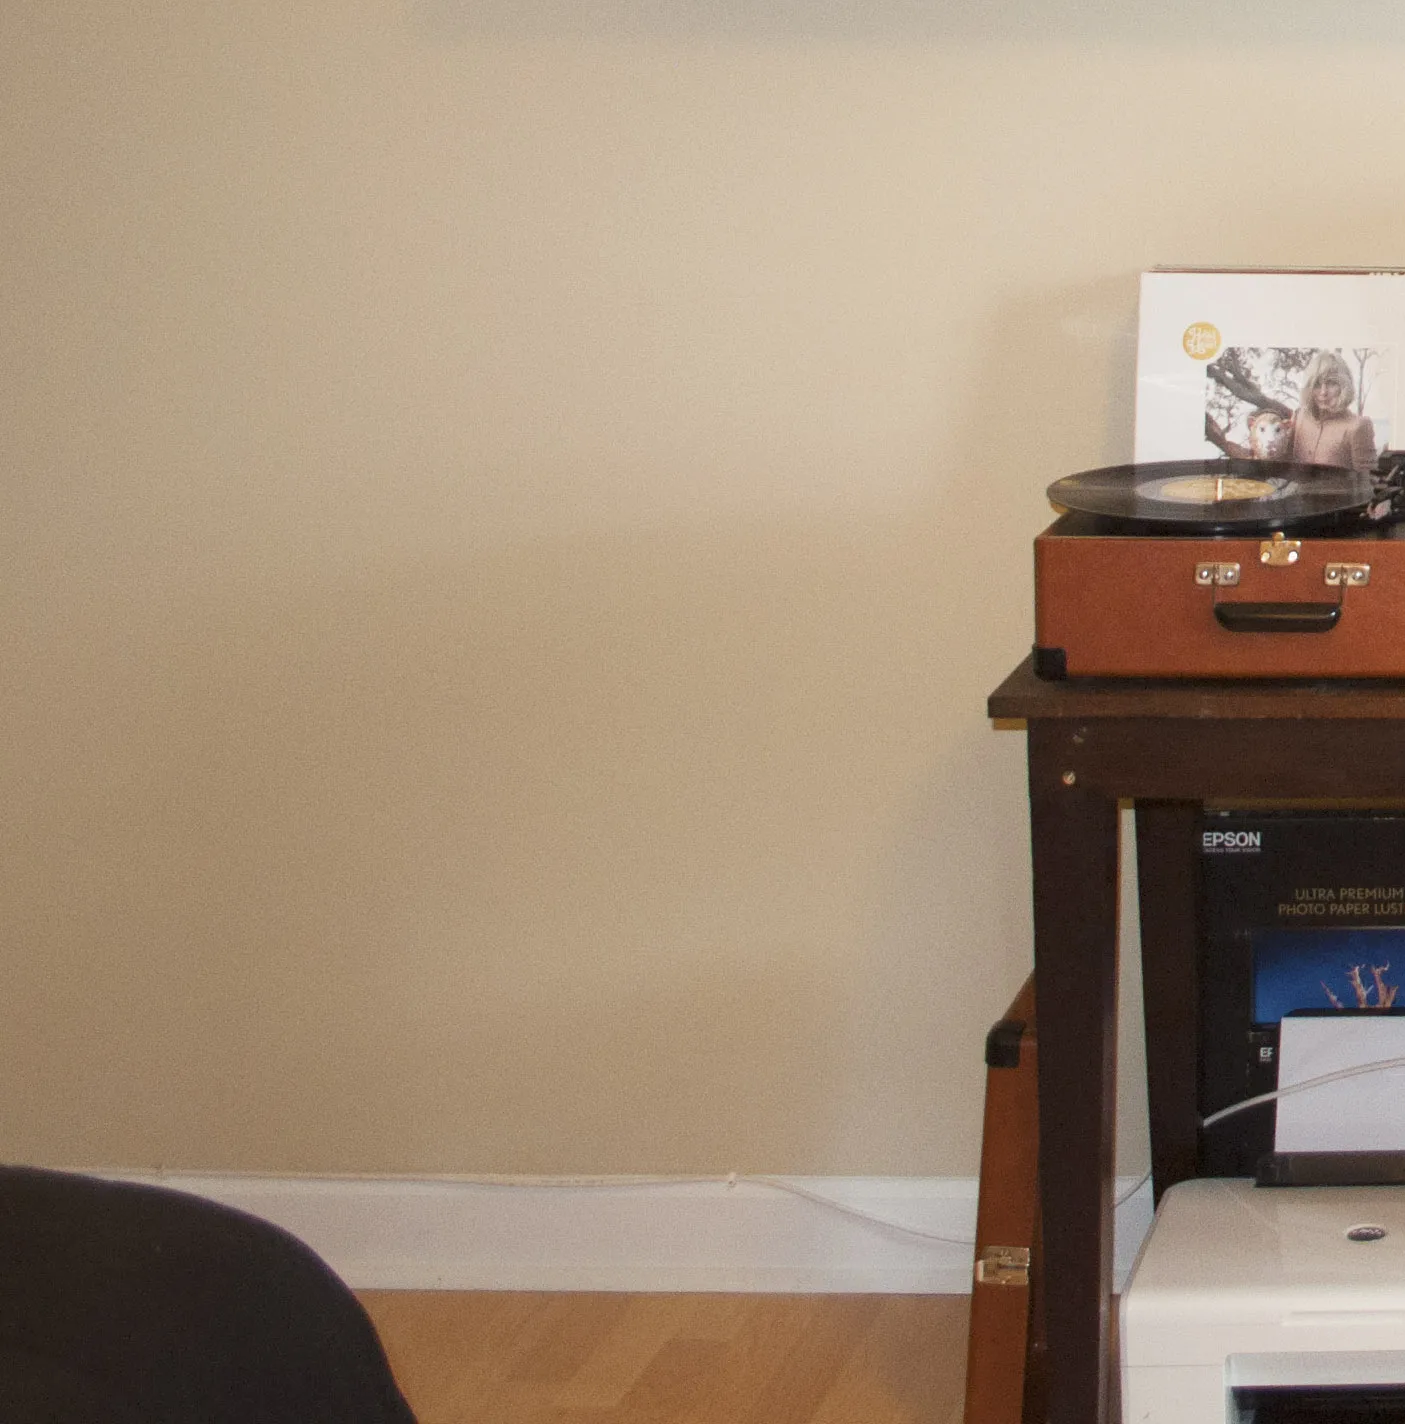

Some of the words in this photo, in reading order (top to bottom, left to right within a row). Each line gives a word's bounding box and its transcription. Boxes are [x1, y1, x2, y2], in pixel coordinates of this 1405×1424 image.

[1203, 831, 1261, 847] EPSON
[1295, 888, 1335, 901] ULTRA
[1340, 888, 1404, 901] PREMIUM
[1278, 903, 1326, 916] PHOTO
[1330, 903, 1371, 915] PAPER
